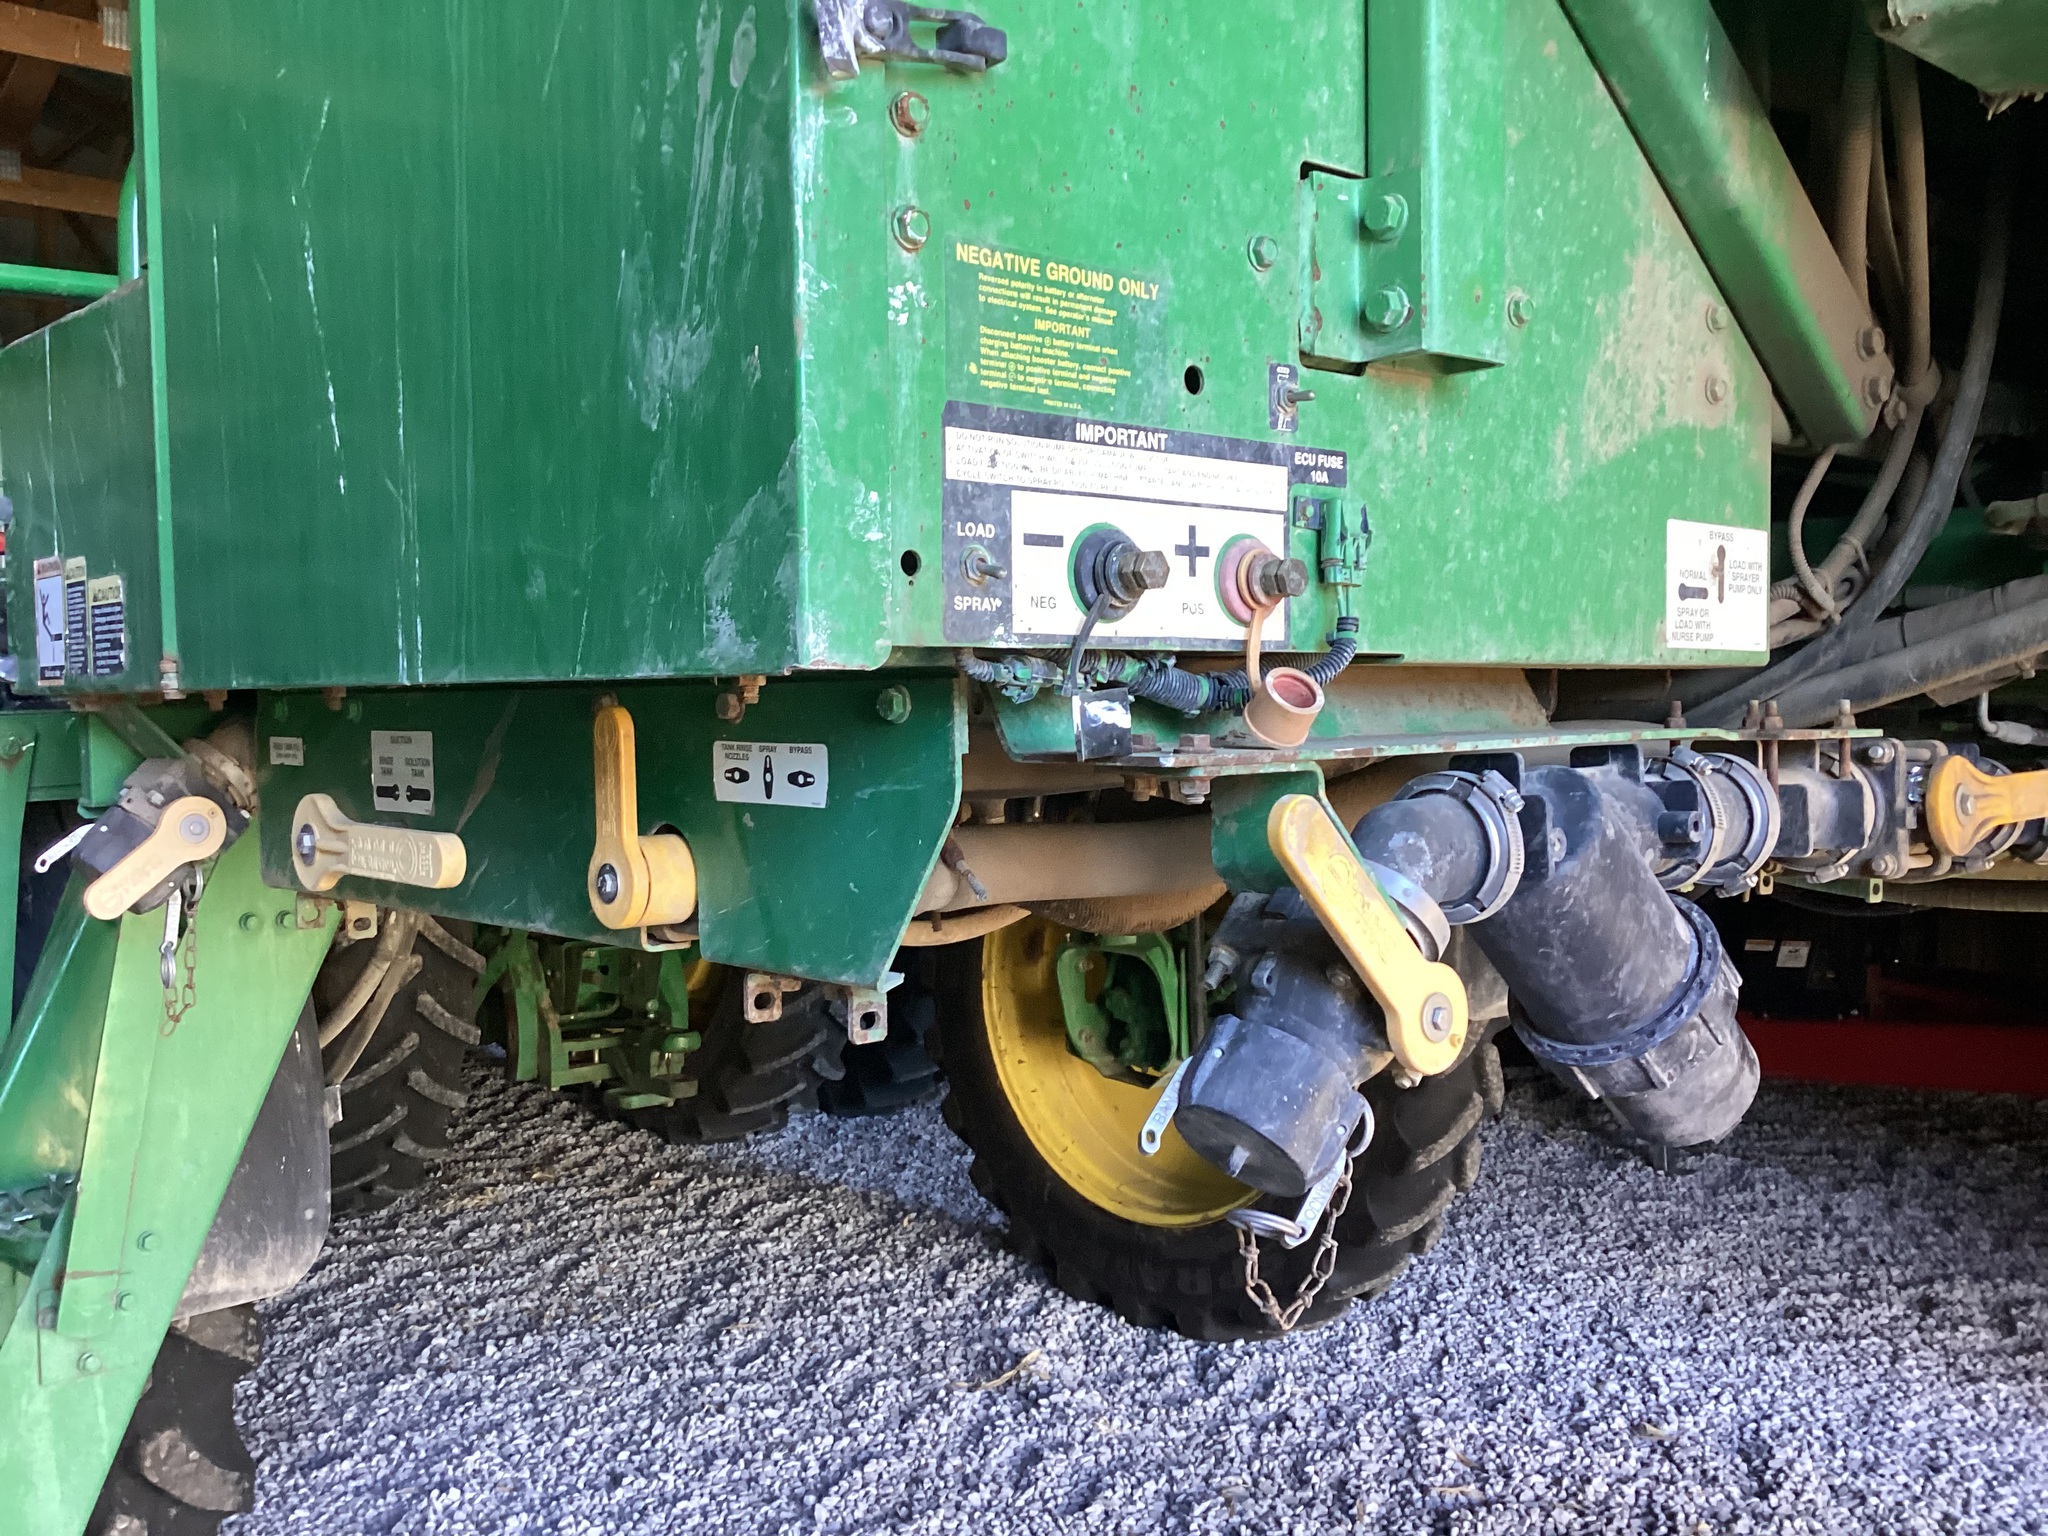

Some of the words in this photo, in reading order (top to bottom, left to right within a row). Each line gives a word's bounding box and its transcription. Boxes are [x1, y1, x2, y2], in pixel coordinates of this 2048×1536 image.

[956, 242, 1041, 277] NEGATIVE
[1046, 262, 1113, 291] GROUND
[1118, 277, 1159, 300] ONLY
[978, 272, 1009, 286] Reversed
[1010, 280, 1035, 292] polarity
[1036, 284, 1043, 292] in
[1044, 285, 1066, 298] battery
[1076, 292, 1105, 304] alternator
[978, 284, 1018, 298] connections
[1020, 292, 1031, 300] will
[1032, 295, 1050, 304] result
[1052, 297, 1059, 305] in
[1060, 299, 1092, 311] permanent
[1093, 305, 1117, 317] damage
[978, 293, 986, 302] to
[987, 296, 1017, 307] electrical
[1018, 302, 1043, 312] system.
[1045, 305, 1057, 315] See
[1058, 309, 1090, 321] operator's
[1034, 319, 1091, 338] IMPORTANT
[980, 325, 1016, 339] Disconnect
[1018, 332, 1043, 343] positive
[1053, 338, 1075, 349] battery
[1076, 342, 1101, 352] terminal
[1102, 346, 1118, 355] when
[980, 337, 1008, 350] charging
[1010, 341, 1032, 353] battery
[1034, 345, 1041, 353] in
[1042, 347, 1070, 358] machine.
[980, 347, 999, 357] When
[1001, 351, 1030, 364] attaching
[1032, 354, 1056, 365] booster
[1082, 364, 1106, 373] connect
[1108, 367, 1131, 377] positive
[980, 358, 1007, 369] terminal
[1017, 363, 1024, 371] to
[1025, 365, 1051, 375] positive
[1052, 368, 1077, 379] terminal
[1078, 373, 1090, 381] and
[1091, 375, 1117, 385] negative
[980, 368, 1007, 379] terminal
[1017, 374, 1024, 382] to
[1082, 384, 1116, 396] connecting
[980, 379, 1008, 390] negative
[1009, 382, 1036, 394] terminal
[1075, 422, 1168, 451] IMPORTANT
[1294, 451, 1317, 466] ECU
[1318, 454, 1344, 470] FUSE
[1310, 470, 1329, 484] 10A
[957, 522, 995, 539] LOAD
[1709, 531, 1734, 542] BYPASS
[1729, 560, 1746, 569] LOAD
[1747, 561, 1763, 571] WITH
[1679, 569, 1707, 581] NORMAL
[1732, 572, 1760, 582] SPRAYER
[1728, 584, 1746, 593] PUMP
[1747, 585, 1763, 595] ONLY
[953, 595, 999, 612] SPRAY
[1030, 597, 1057, 609] NEG
[1182, 602, 1206, 615] POS
[1677, 607, 1698, 617] SPRAY
[1699, 608, 1709, 618] OR
[1675, 620, 1694, 630] LOAD
[1695, 621, 1711, 630] WITH
[1671, 631, 1694, 641] NURSE
[1695, 632, 1714, 642] PUMP
[721, 743, 735, 751] TANK
[736, 744, 752, 752] RINSE
[759, 745, 777, 753] SPRAY
[789, 746, 812, 754] BYPASS
[725, 753, 749, 761] NOZZLES
